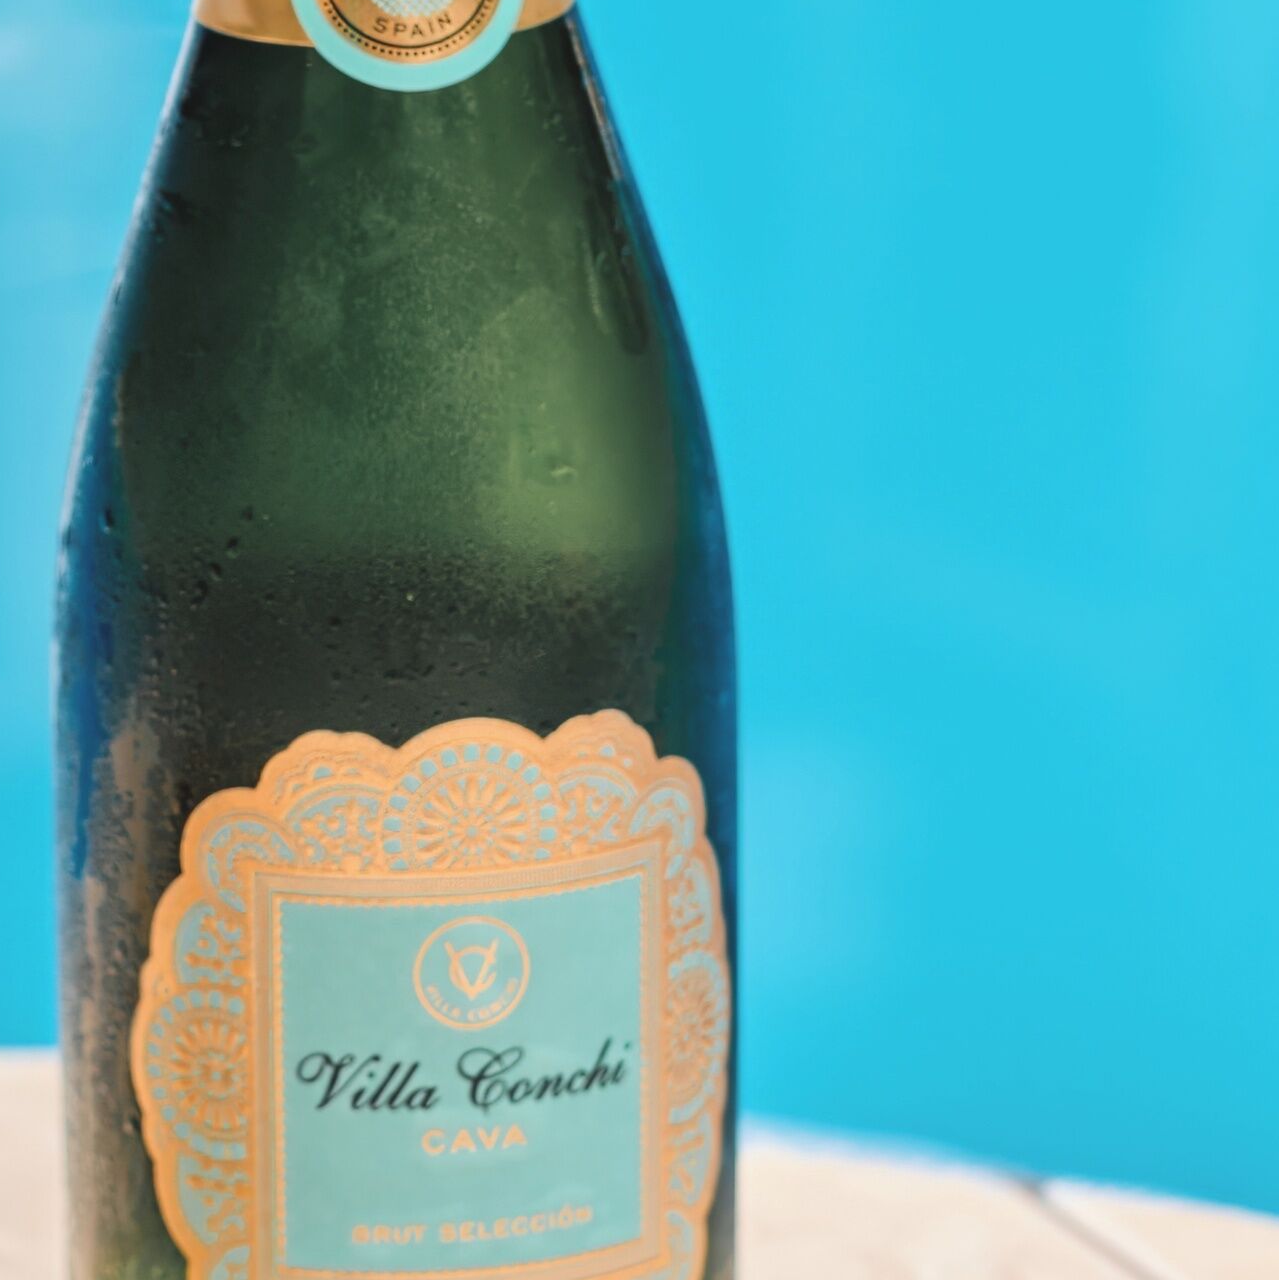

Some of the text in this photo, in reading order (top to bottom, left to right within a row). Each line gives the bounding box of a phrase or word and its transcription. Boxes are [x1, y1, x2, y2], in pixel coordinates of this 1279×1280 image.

[373, 14, 452, 38] SPAIN
[296, 1035, 633, 1115] Villa Conchi
[422, 1124, 528, 1157] CAVA
[351, 1204, 593, 1245] BRUT SELECCIÓN
